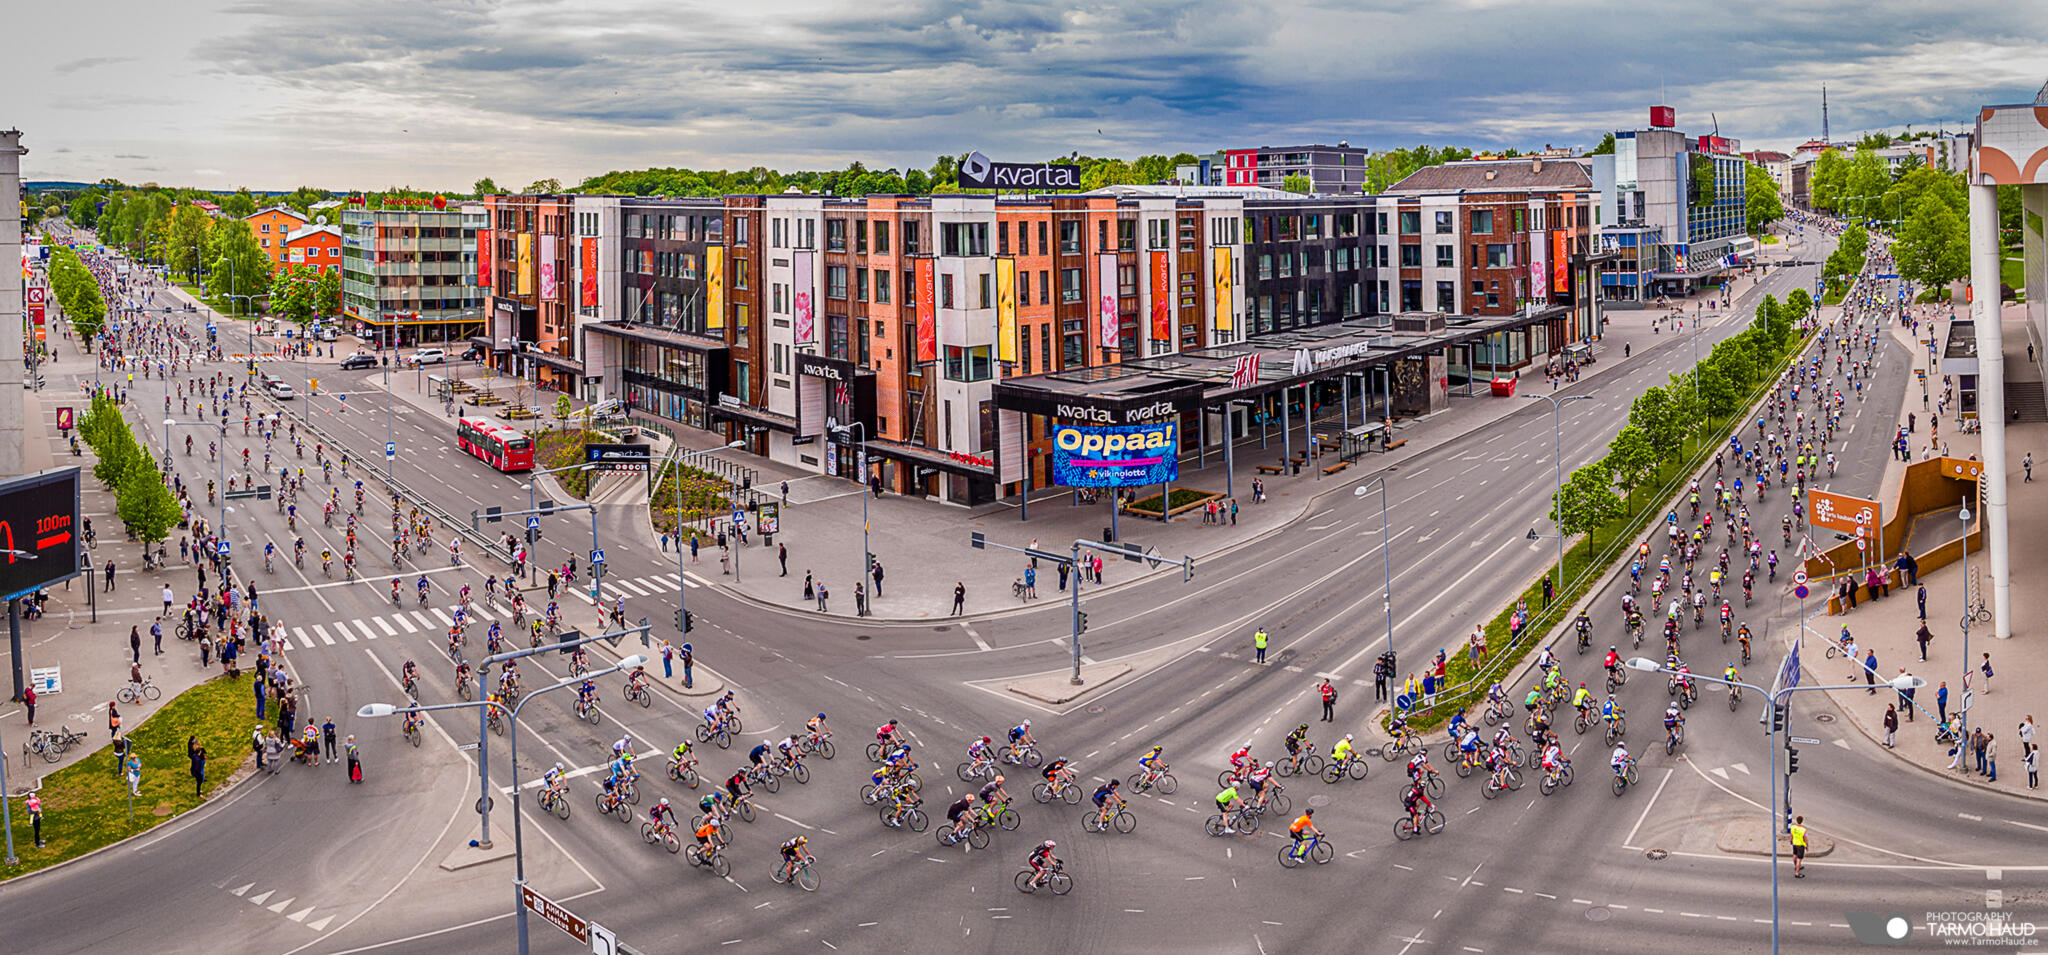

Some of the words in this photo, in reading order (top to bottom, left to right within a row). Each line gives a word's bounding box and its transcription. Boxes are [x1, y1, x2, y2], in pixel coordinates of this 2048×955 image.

[383, 196, 432, 206] Swedbank
[1232, 352, 1260, 389] H&M
[1058, 425, 1173, 456] Oppaa!
[1100, 469, 1146, 480] vikinglotto
[37, 515, 70, 535] 100m
[546, 903, 569, 923] AHHAA
[547, 911, 569, 931] keskus
